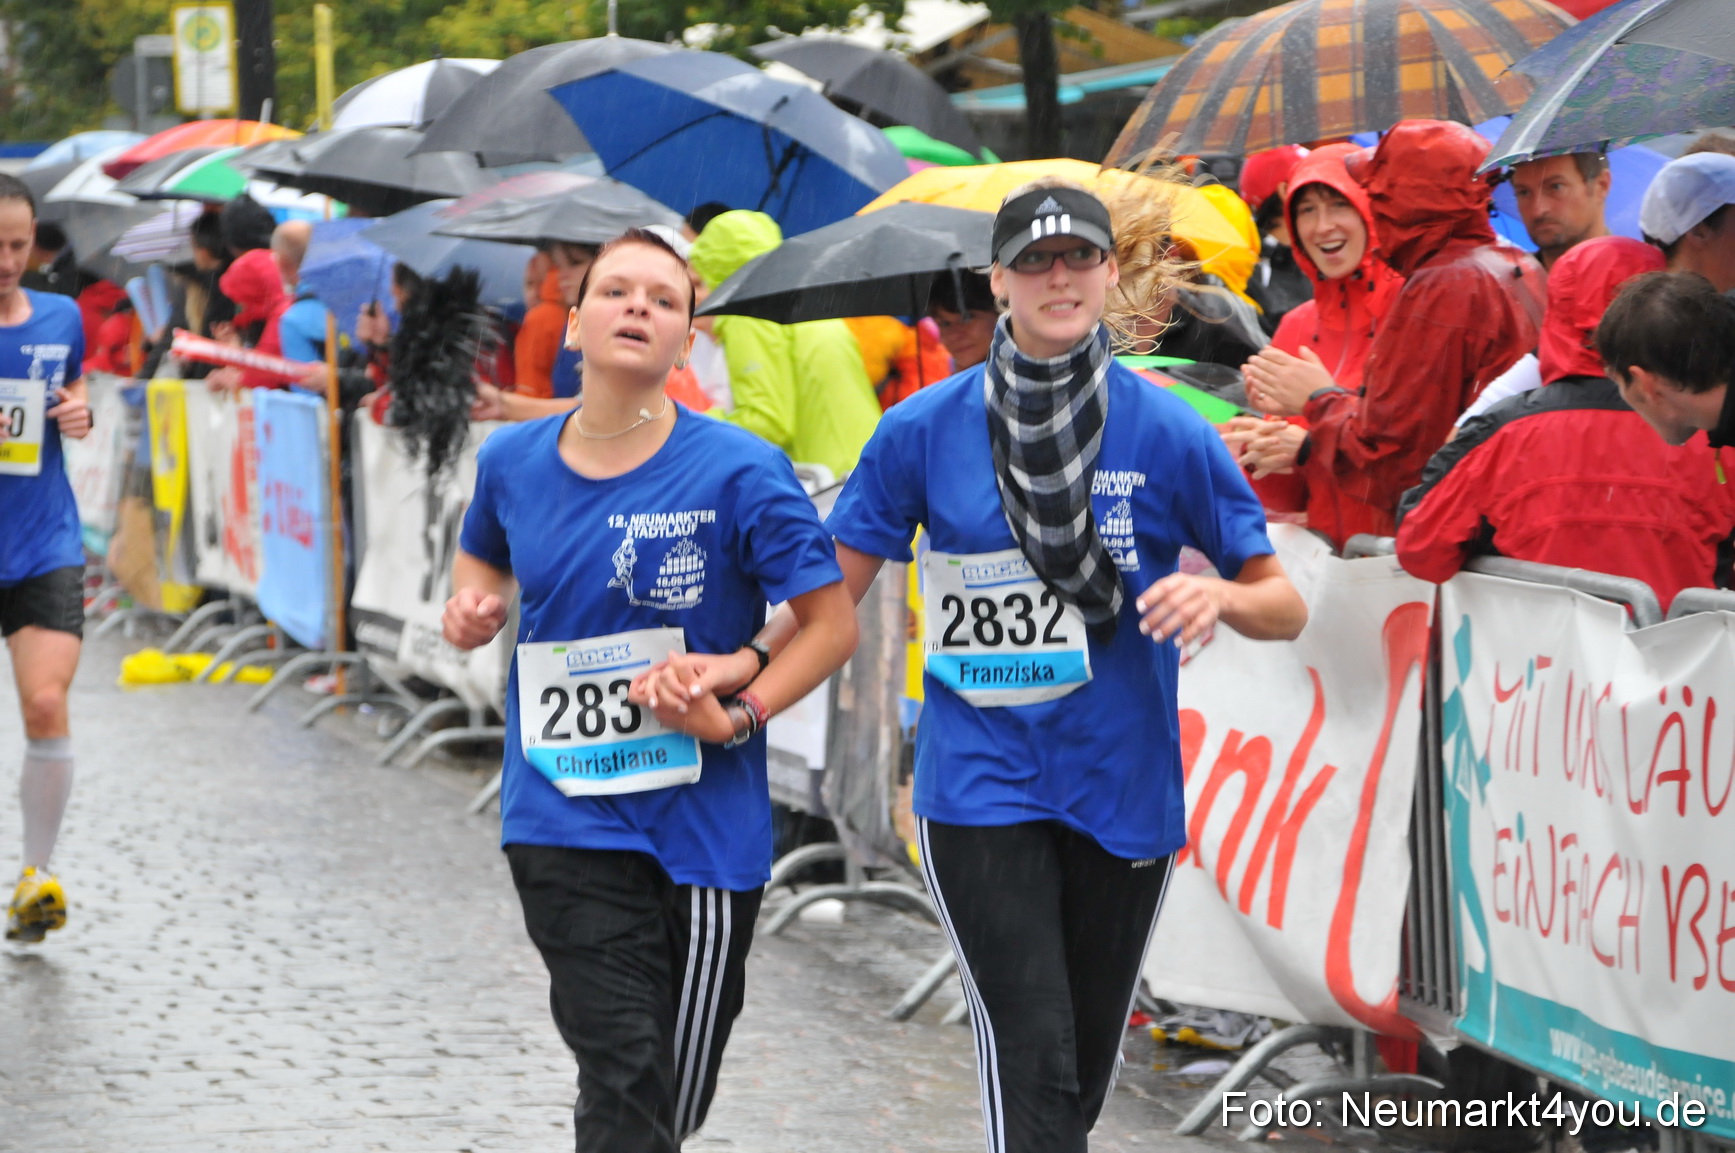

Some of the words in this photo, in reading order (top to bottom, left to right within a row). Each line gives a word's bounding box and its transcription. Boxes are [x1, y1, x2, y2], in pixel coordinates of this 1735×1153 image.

[607, 514, 628, 529] 12.
[630, 509, 716, 532] NEUMARKTER
[626, 522, 698, 539] STADTLAUF
[941, 589, 1068, 648] 2832
[566, 643, 632, 668] BOCK
[959, 661, 1055, 685] Franziska
[540, 679, 642, 741] 283
[556, 747, 668, 776] Christiane
